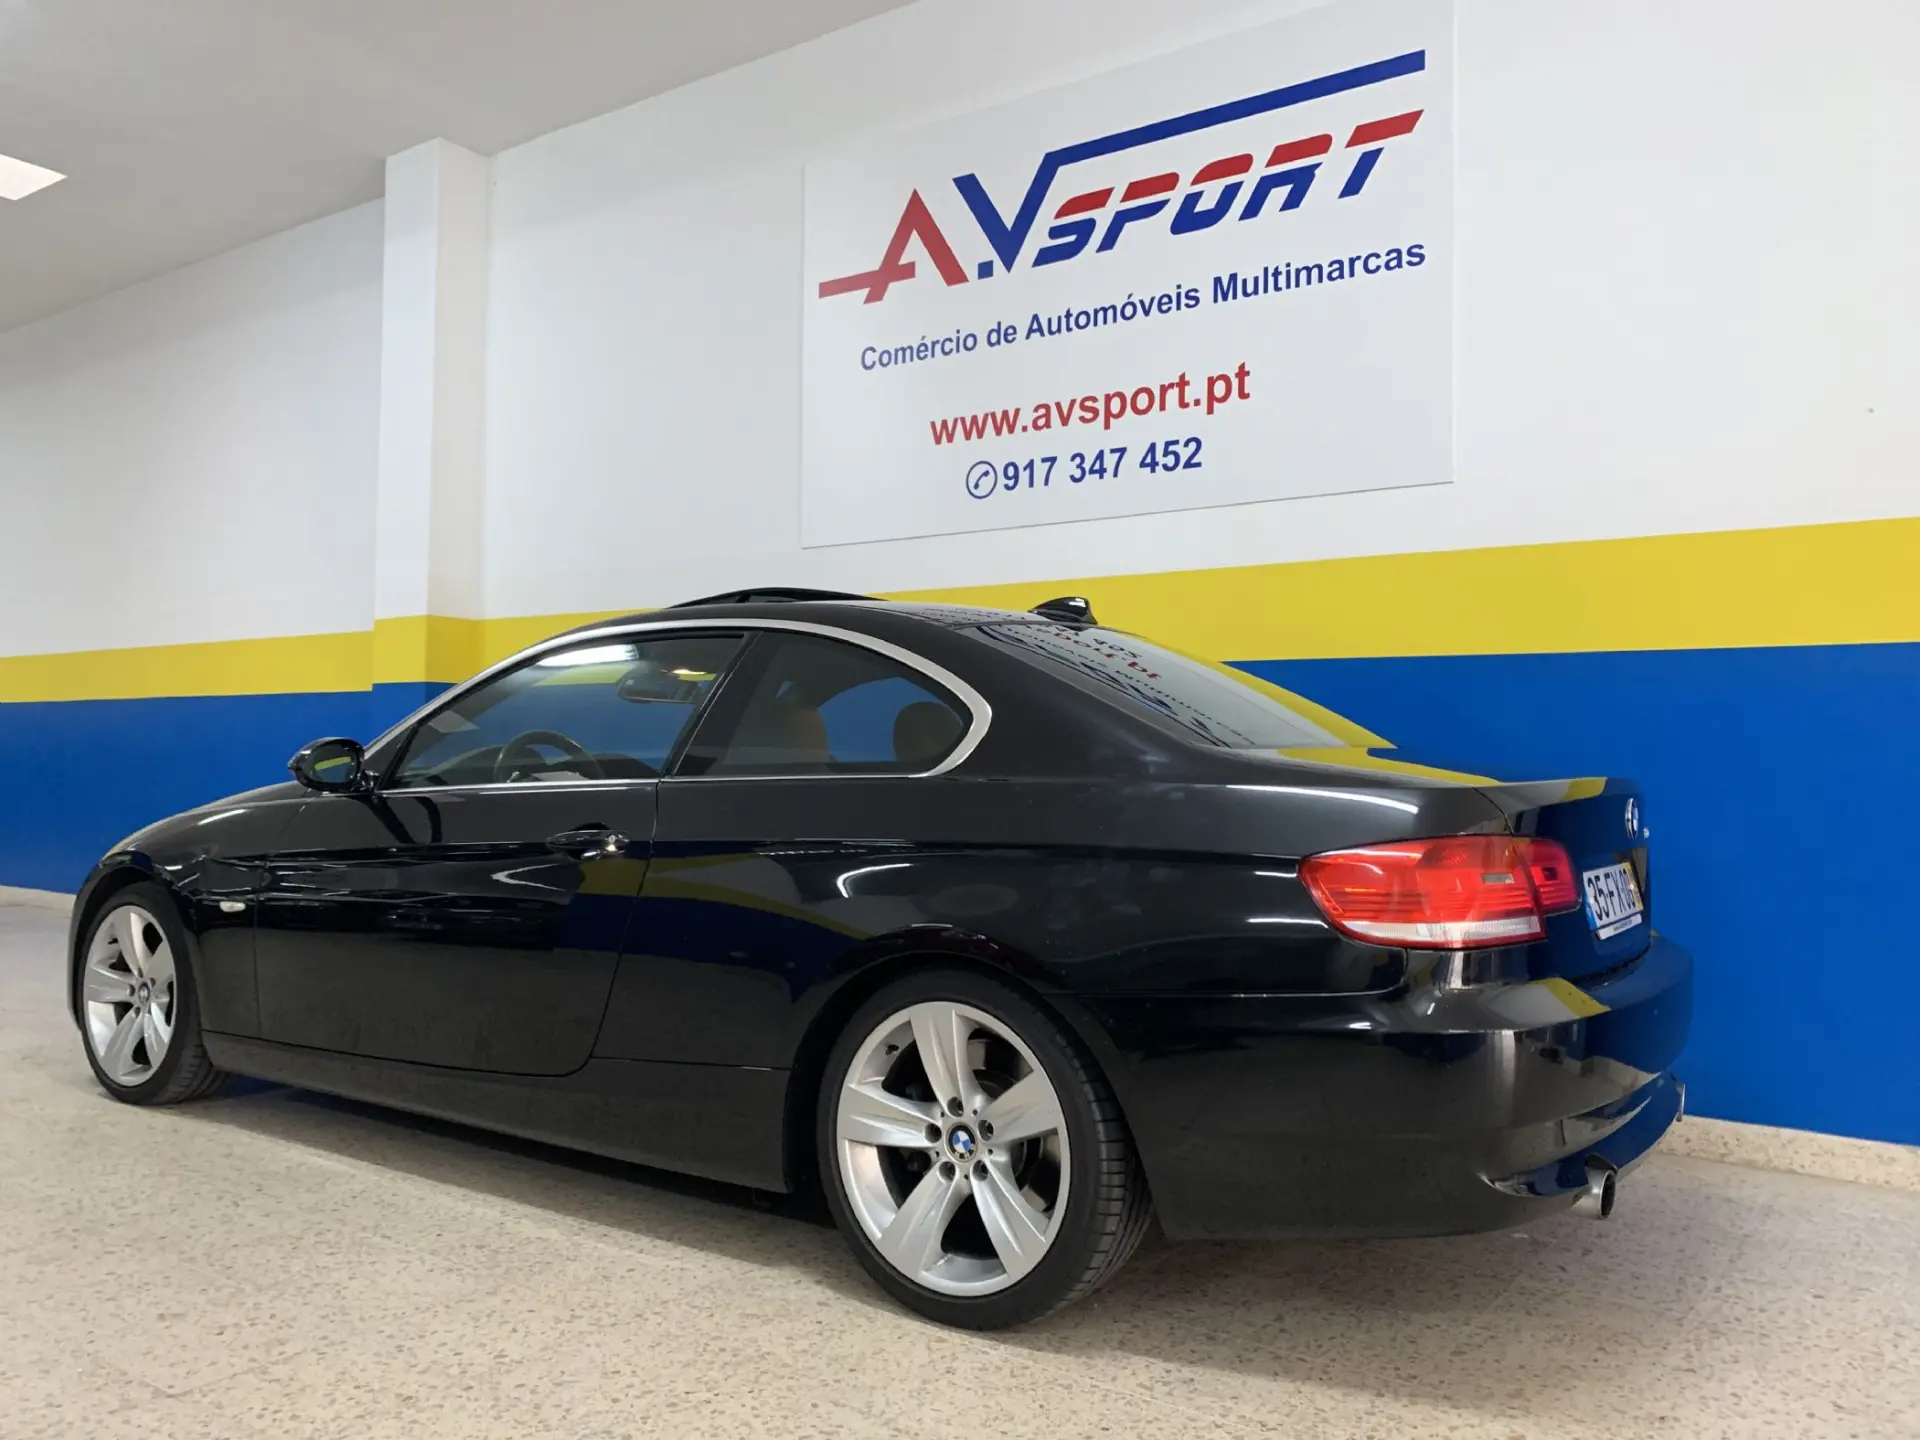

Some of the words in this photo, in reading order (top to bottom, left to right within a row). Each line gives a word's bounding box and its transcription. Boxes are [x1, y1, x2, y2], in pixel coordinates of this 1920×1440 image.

[860, 334, 979, 370] Comércio
[986, 323, 1019, 347] de
[1025, 285, 1202, 340] Automóveis
[1211, 243, 1426, 305] Multimarcas
[930, 362, 1252, 446] www.avsport.pt
[1001, 456, 1059, 491] 917
[1069, 447, 1128, 484] 347
[1137, 435, 1205, 473] 452
